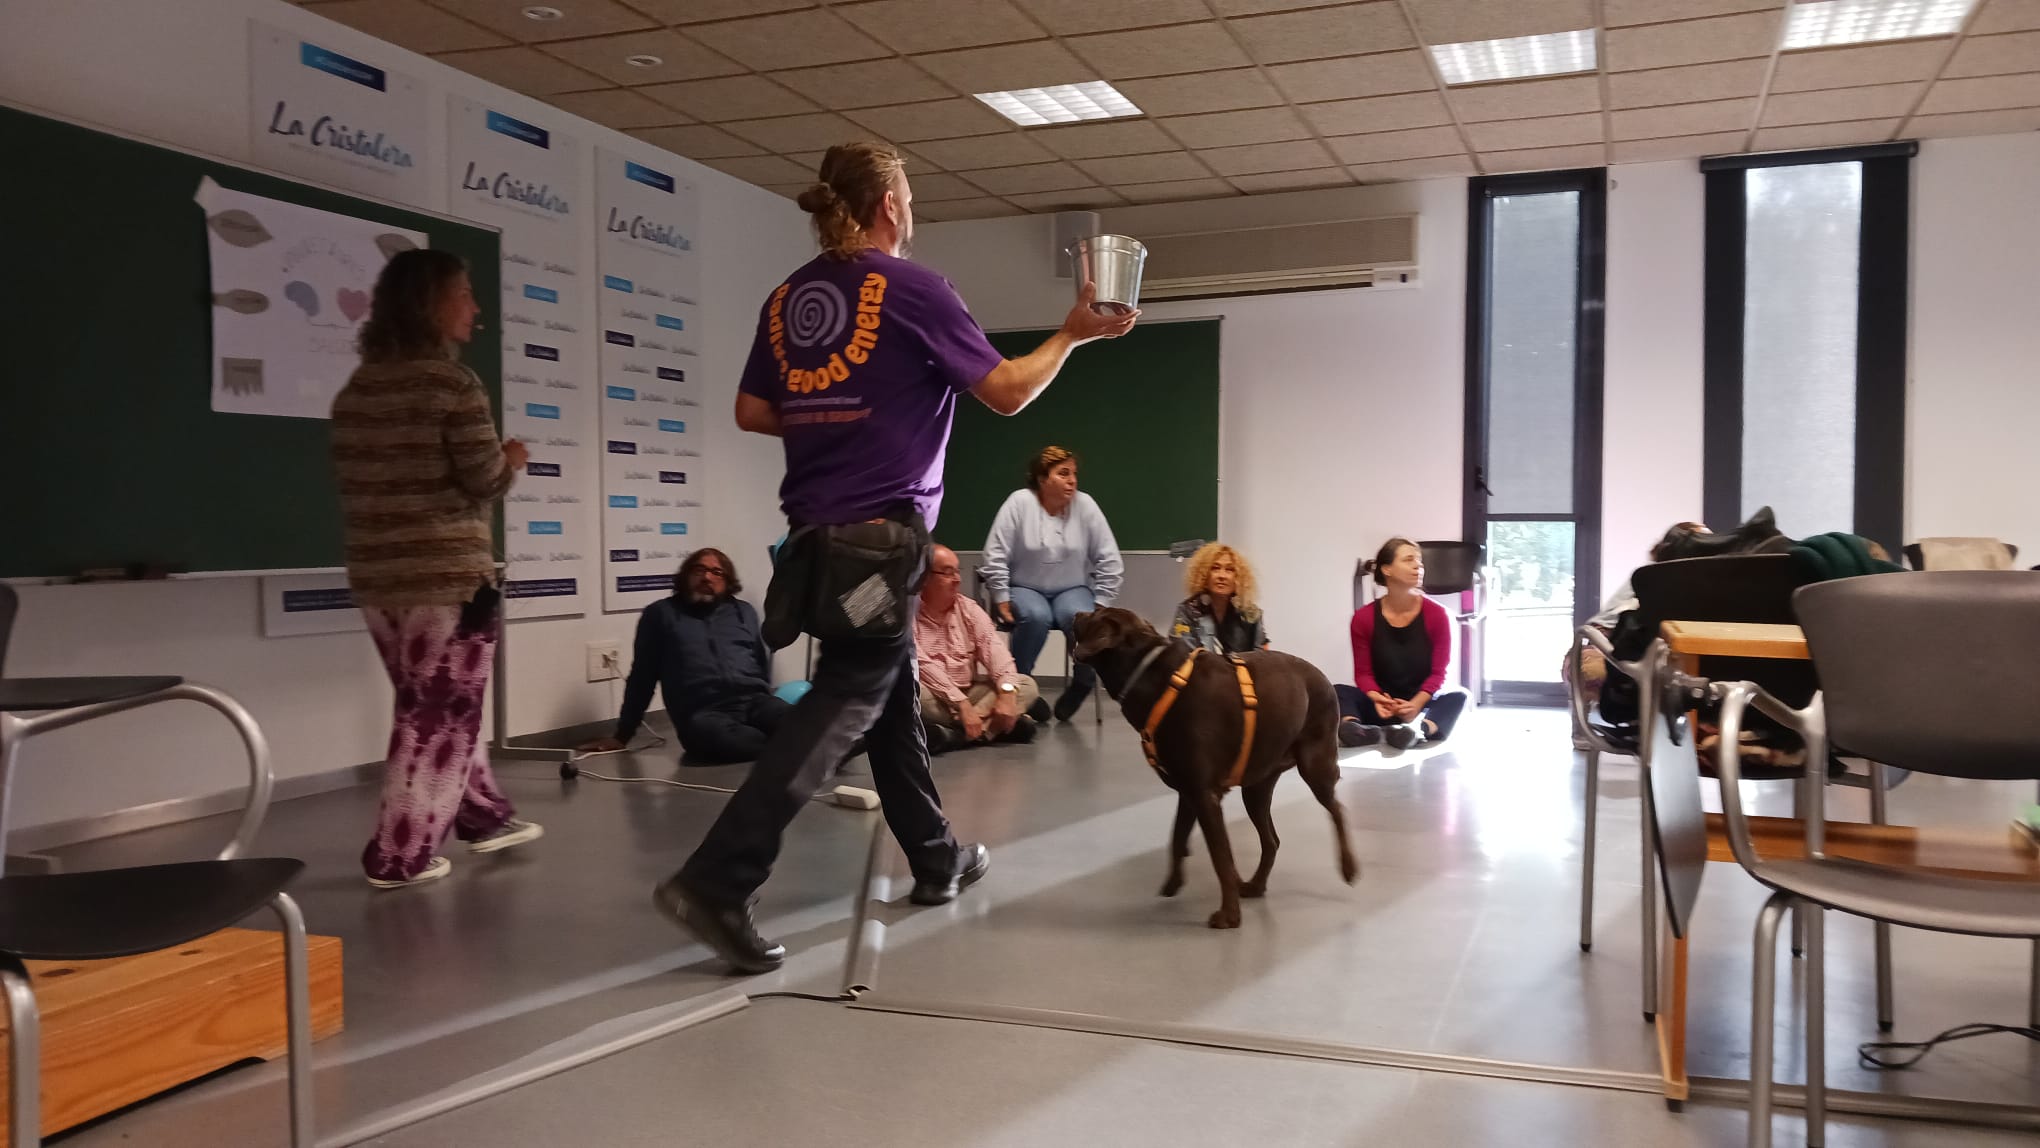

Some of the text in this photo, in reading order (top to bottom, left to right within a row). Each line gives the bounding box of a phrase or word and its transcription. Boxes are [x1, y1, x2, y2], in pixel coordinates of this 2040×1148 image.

[268, 100, 304, 135] La
[310, 115, 413, 168] Cristalera
[462, 161, 488, 190] La
[607, 206, 627, 232] La
[787, 352, 850, 394] good
[844, 272, 887, 364] energy
